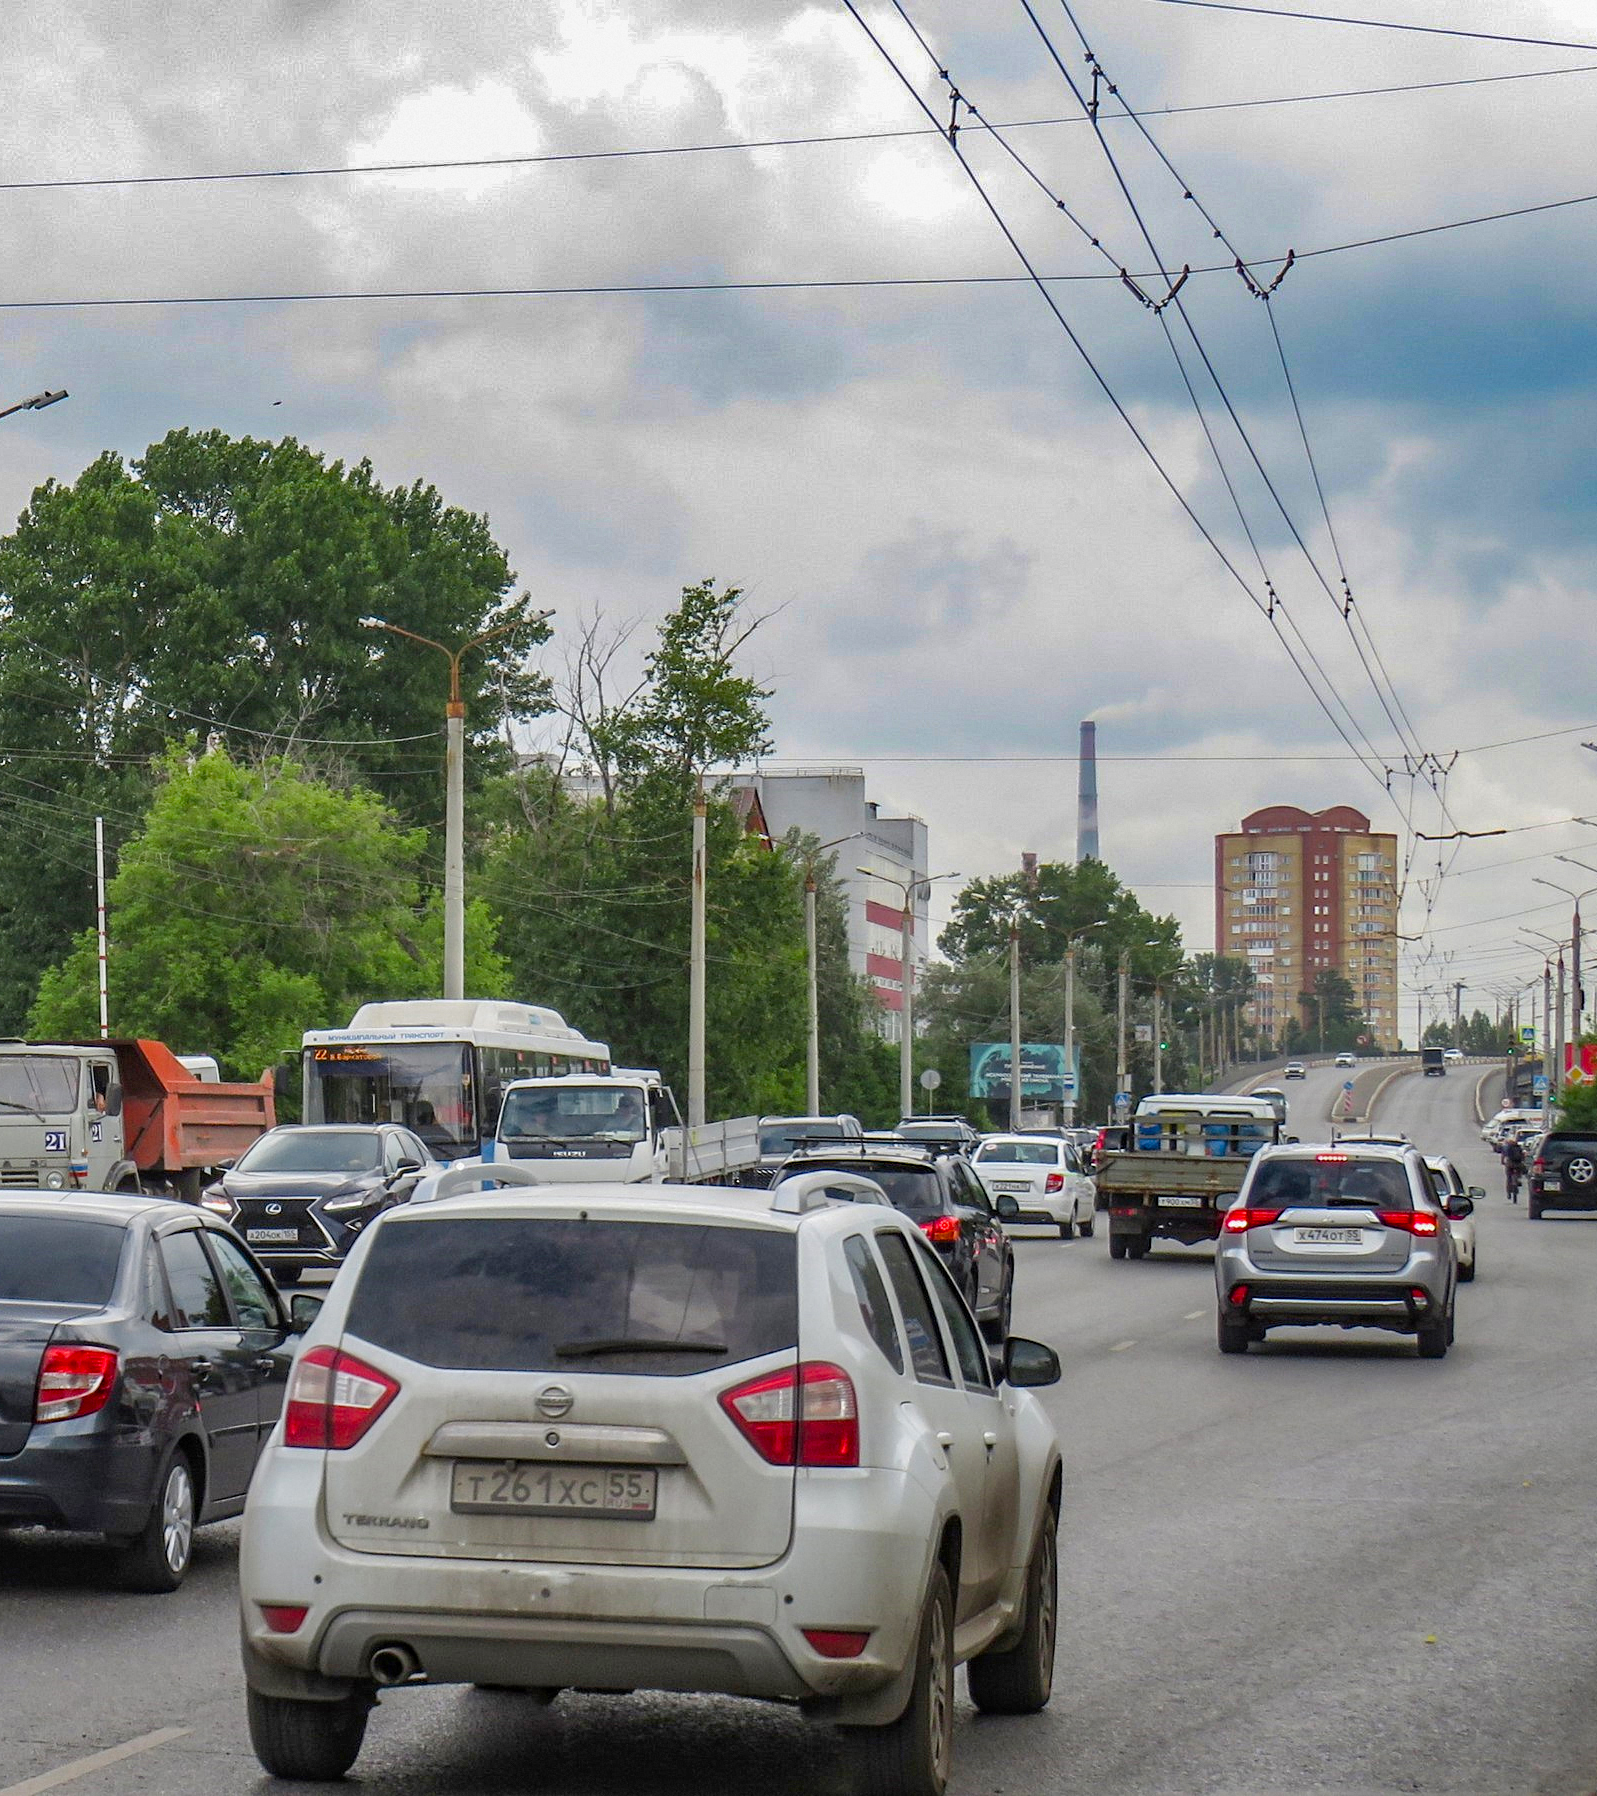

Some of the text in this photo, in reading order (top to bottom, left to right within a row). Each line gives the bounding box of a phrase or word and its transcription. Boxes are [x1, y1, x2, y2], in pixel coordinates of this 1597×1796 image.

[400, 1032, 444, 1040] ТРАНСПОРТ
[314, 1048, 328, 1060] 22
[91, 1123, 102, 1142] 21
[45, 1133, 66, 1151] 21
[553, 1150, 586, 1158] ISUZU
[1298, 1229, 1358, 1241] Х474ОТ 55
[468, 1470, 642, 1505] Т261ХС 55
[343, 1513, 430, 1529] TERRANO
